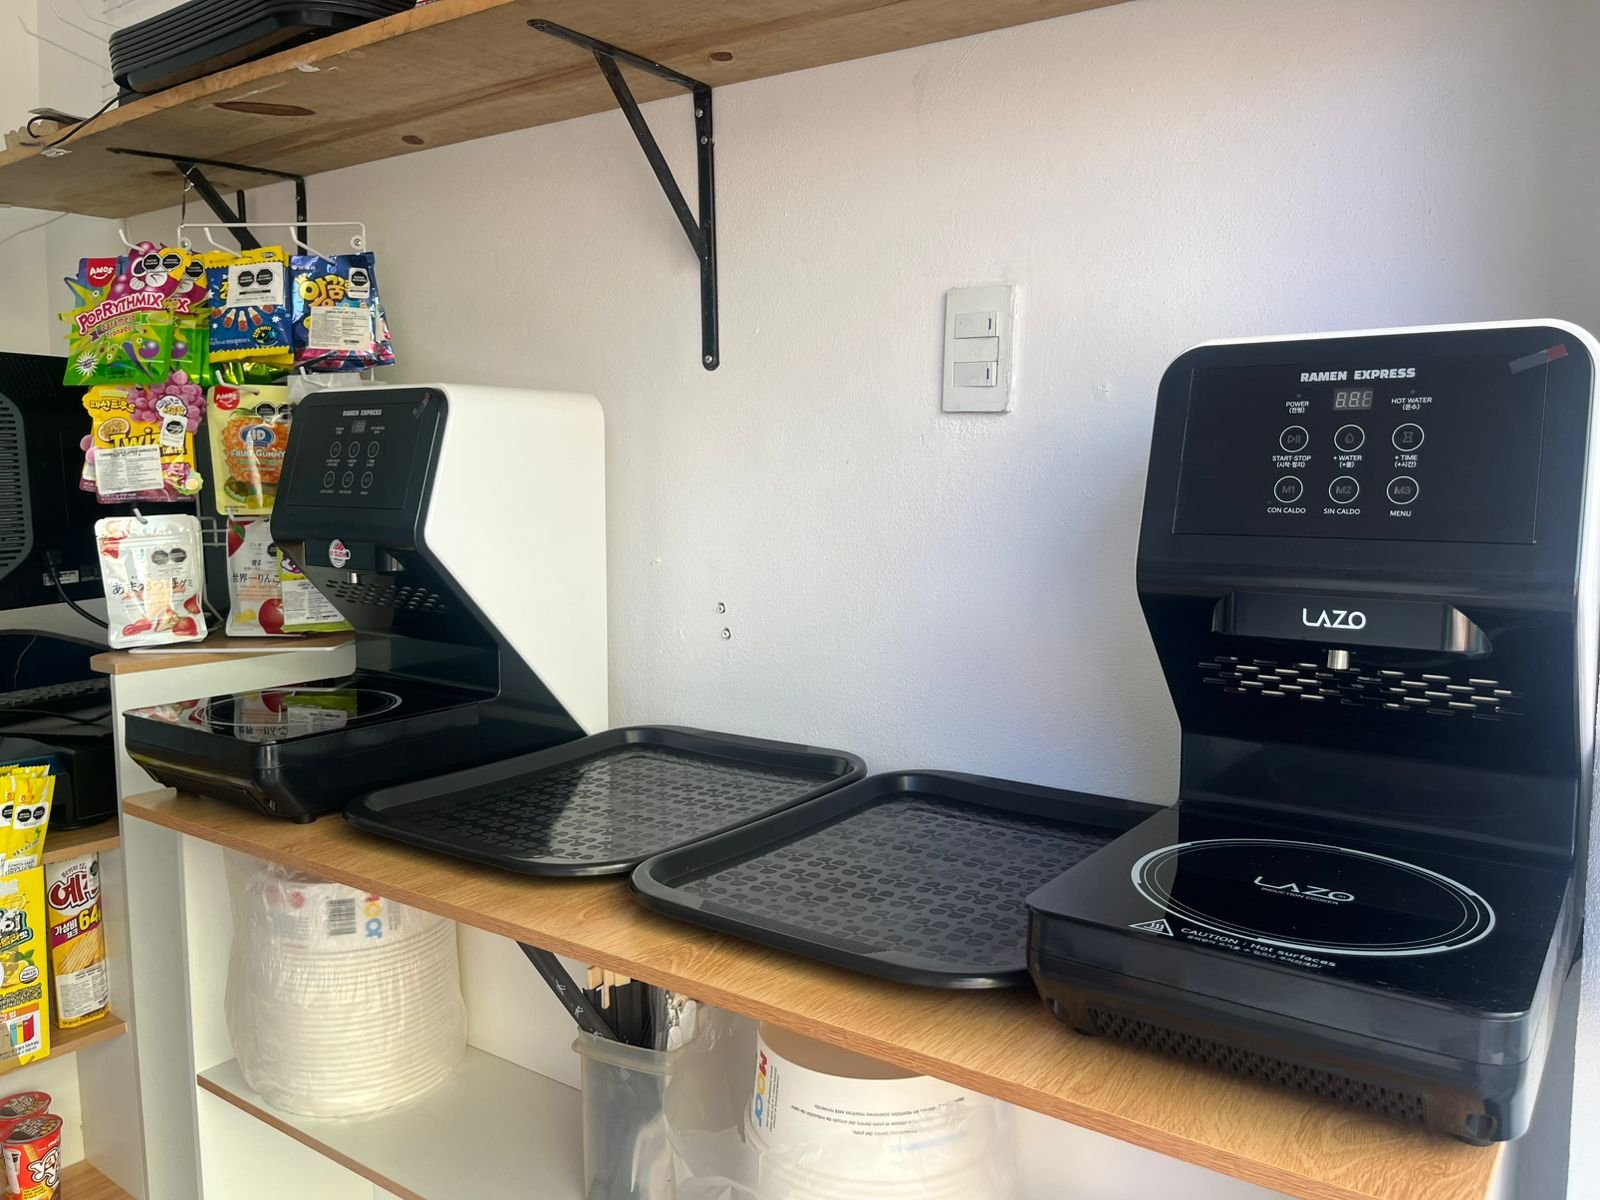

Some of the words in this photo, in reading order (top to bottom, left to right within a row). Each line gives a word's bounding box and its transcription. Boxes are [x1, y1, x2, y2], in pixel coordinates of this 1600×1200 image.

[90, 266, 115, 277] AMOS
[1300, 371, 1348, 382] RAMEN
[1353, 367, 1416, 380] EXPRESS
[216, 392, 238, 401] AMOS
[256, 449, 285, 458] GUMMY
[1281, 485, 1296, 494] M1
[1335, 485, 1352, 495] M2
[1394, 486, 1412, 495] M3
[1302, 608, 1366, 629] LAZO
[1254, 876, 1354, 901] LAZO
[1261, 887, 1304, 898] INDUCTION
[1305, 896, 1339, 905] COOKER
[1180, 927, 1239, 944] CAUTION
[1250, 943, 1274, 953] Hot
[1277, 950, 1337, 967] surfaces
